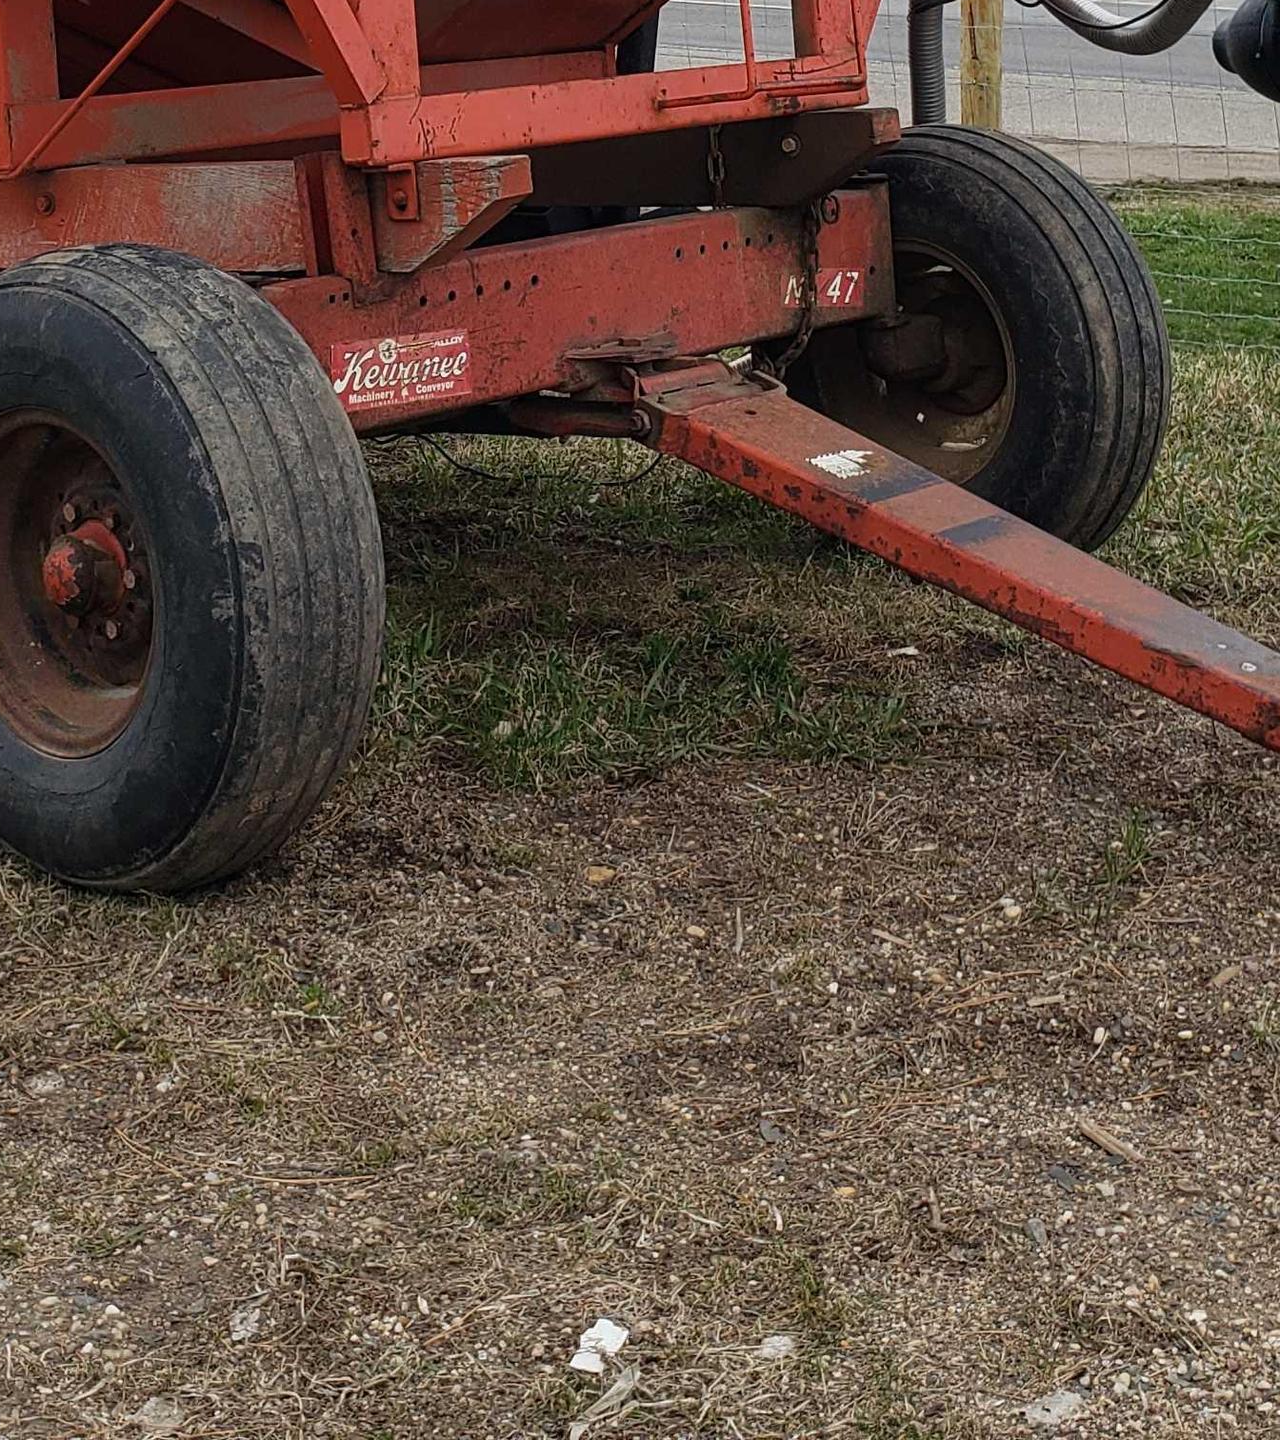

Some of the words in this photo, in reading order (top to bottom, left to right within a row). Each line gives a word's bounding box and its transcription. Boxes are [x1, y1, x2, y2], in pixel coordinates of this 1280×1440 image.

[333, 348, 468, 395] Kewanee
[348, 389, 395, 406] Machinery
[415, 380, 455, 395] Conveyor
